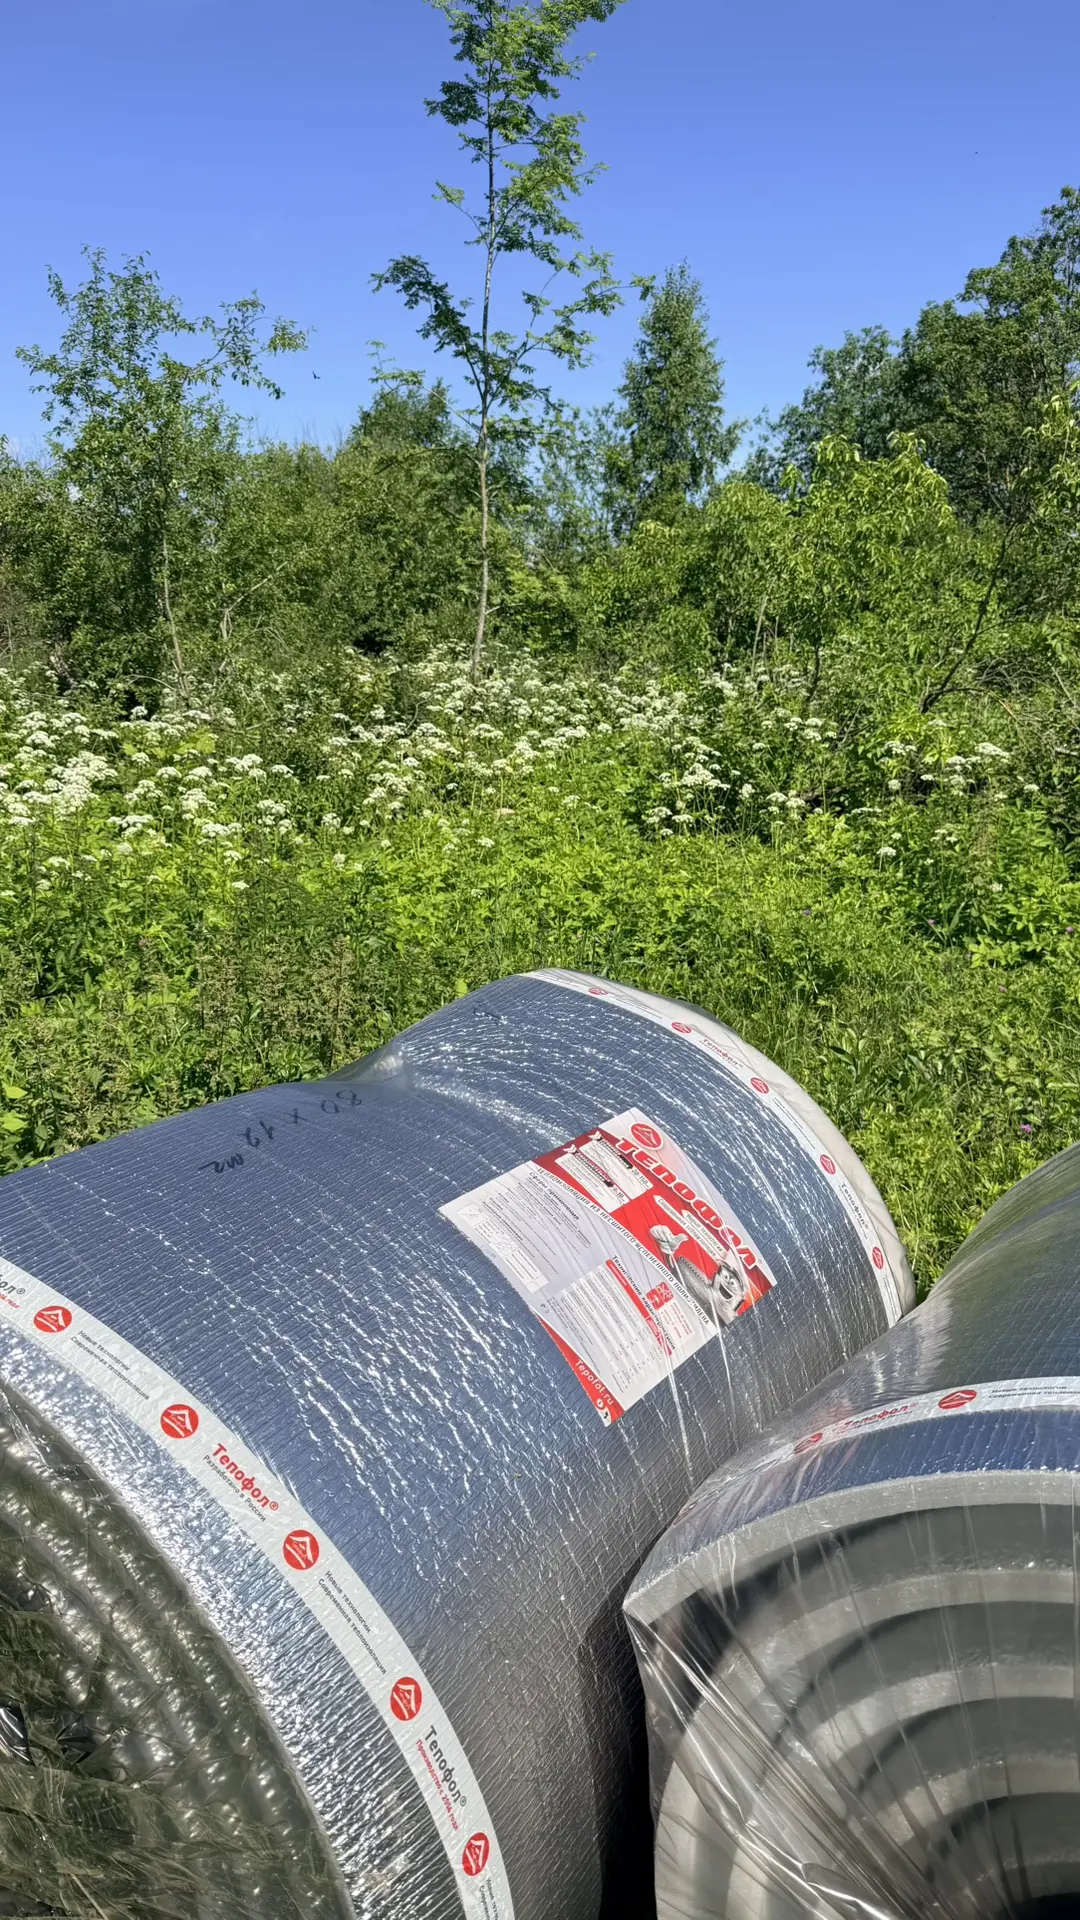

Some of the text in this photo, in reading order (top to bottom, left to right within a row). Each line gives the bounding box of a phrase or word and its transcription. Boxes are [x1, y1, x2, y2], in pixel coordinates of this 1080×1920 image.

[599, 1210, 636, 1244] НЕСШИТОГО
[617, 1137, 757, 1269] ТЕПОФОЛ
[69, 1335, 151, 1401] Современная теплоизоляция
[77, 1329, 131, 1372] Новые технологии
[574, 1358, 615, 1406] Tepofol.ru
[202, 1454, 240, 1494] Разработано
[243, 1497, 267, 1522] России
[316, 1577, 388, 1675] Современная теплоизоляция
[323, 1569, 372, 1634] Новые технологии
[414, 1738, 443, 1790] Производство
